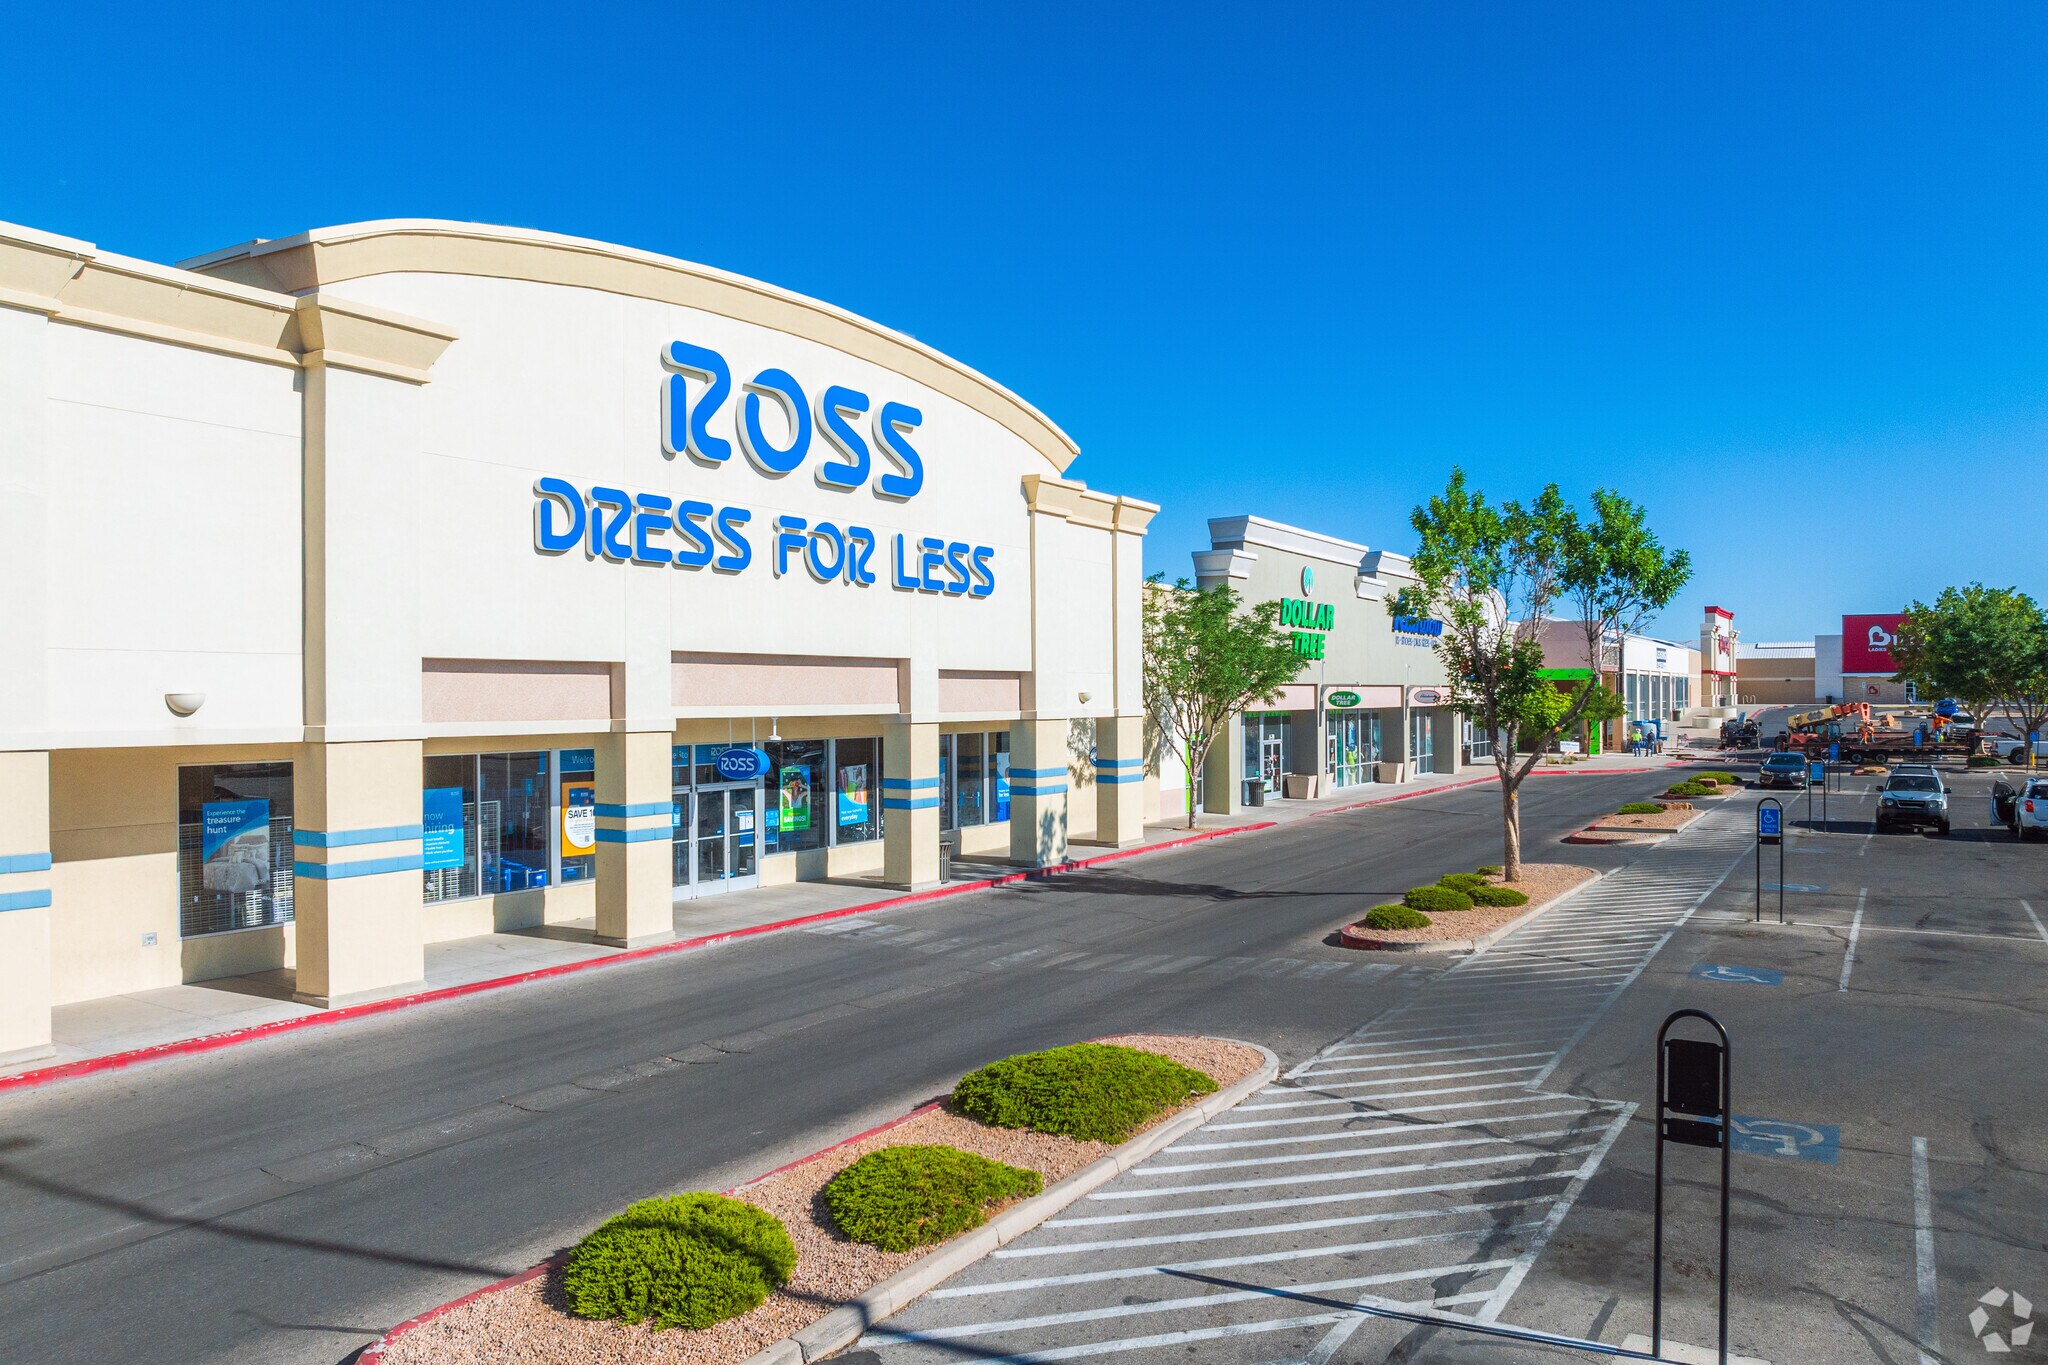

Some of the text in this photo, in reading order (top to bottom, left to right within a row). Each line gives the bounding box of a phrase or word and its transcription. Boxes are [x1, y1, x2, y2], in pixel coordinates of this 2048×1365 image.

[662, 340, 924, 500] ROSS
[534, 477, 995, 598] DRESS FOR LESS
[1280, 598, 1334, 630] DOLLAR
[1291, 632, 1325, 660] TREE
[721, 758, 755, 771] ROSS
[424, 812, 443, 821] now
[568, 809, 588, 819] SAVE
[424, 823, 455, 835] hiring
